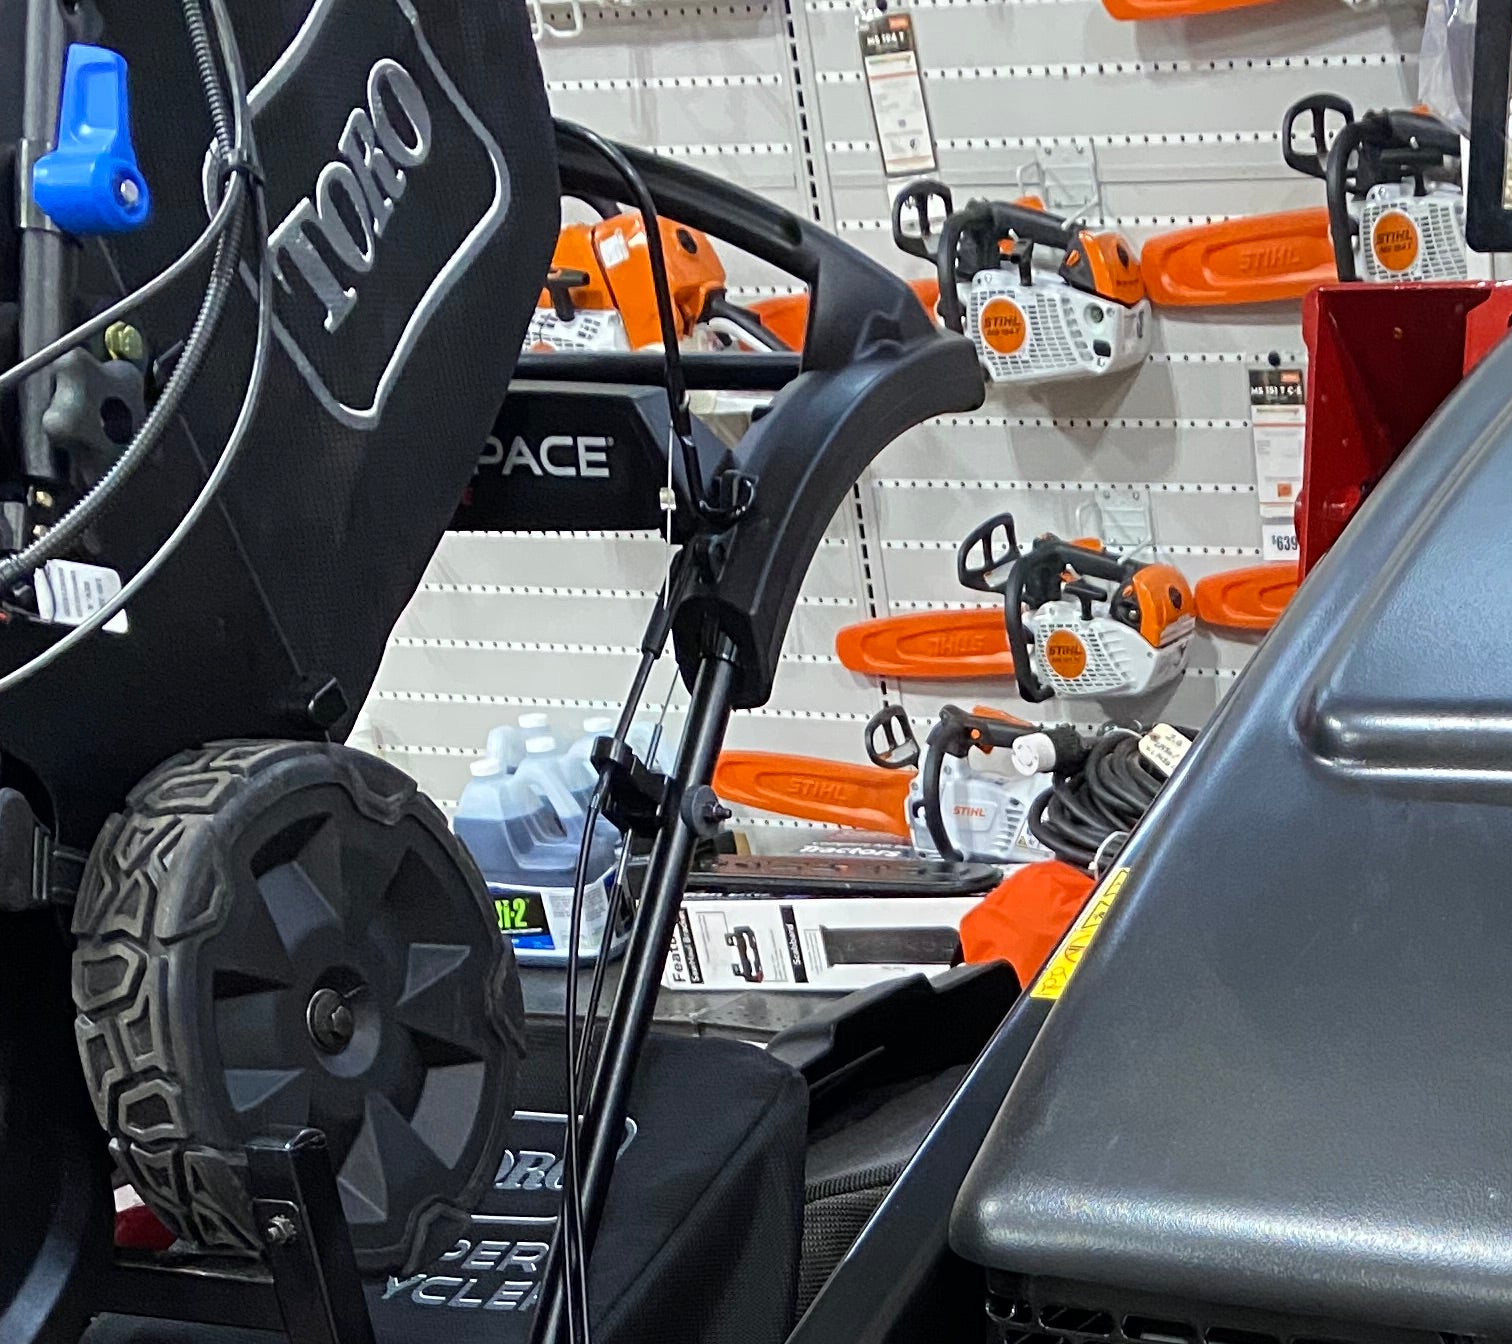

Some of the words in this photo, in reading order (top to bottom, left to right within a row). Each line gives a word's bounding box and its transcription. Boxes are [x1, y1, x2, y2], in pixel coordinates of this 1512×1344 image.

[267, 58, 432, 334] TORO
[1241, 247, 1299, 273] STIHL
[790, 778, 848, 800] STIHL
[953, 805, 986, 817] STIHL
[785, 923, 801, 965] Scabbard
